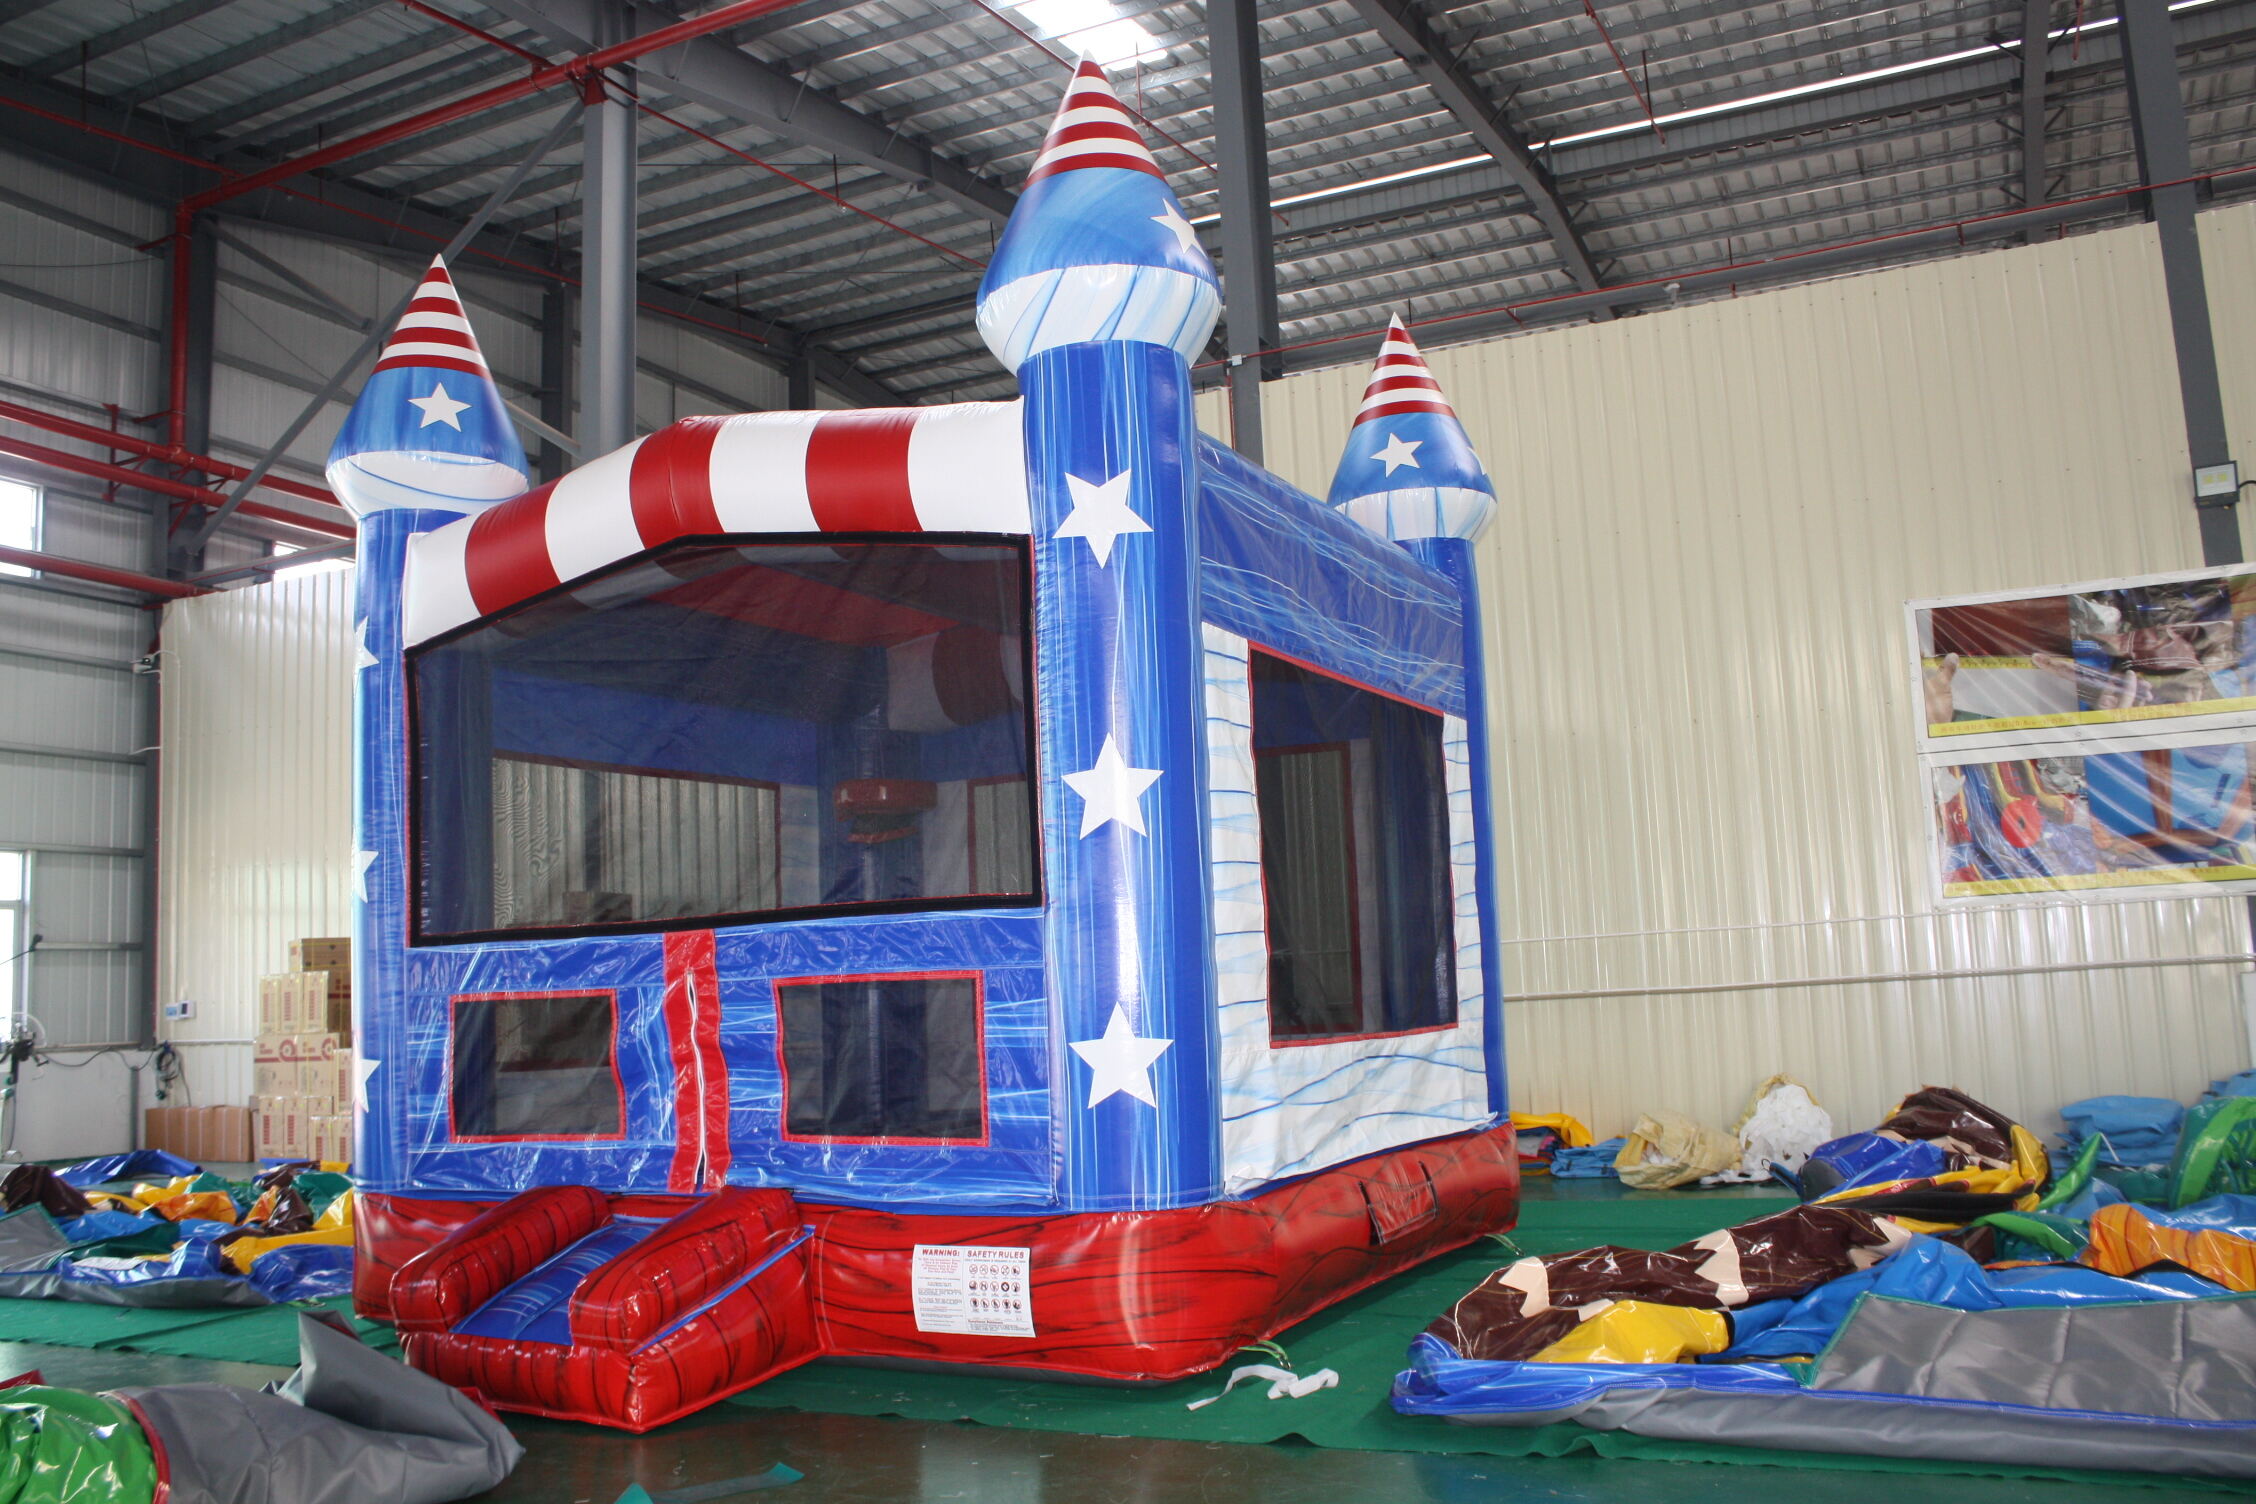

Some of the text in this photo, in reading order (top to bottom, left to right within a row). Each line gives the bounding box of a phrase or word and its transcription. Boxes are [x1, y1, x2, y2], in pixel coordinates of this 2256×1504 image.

[922, 1248, 960, 1257] WARNING:
[967, 1250, 1025, 1259] SAFETY RULES
